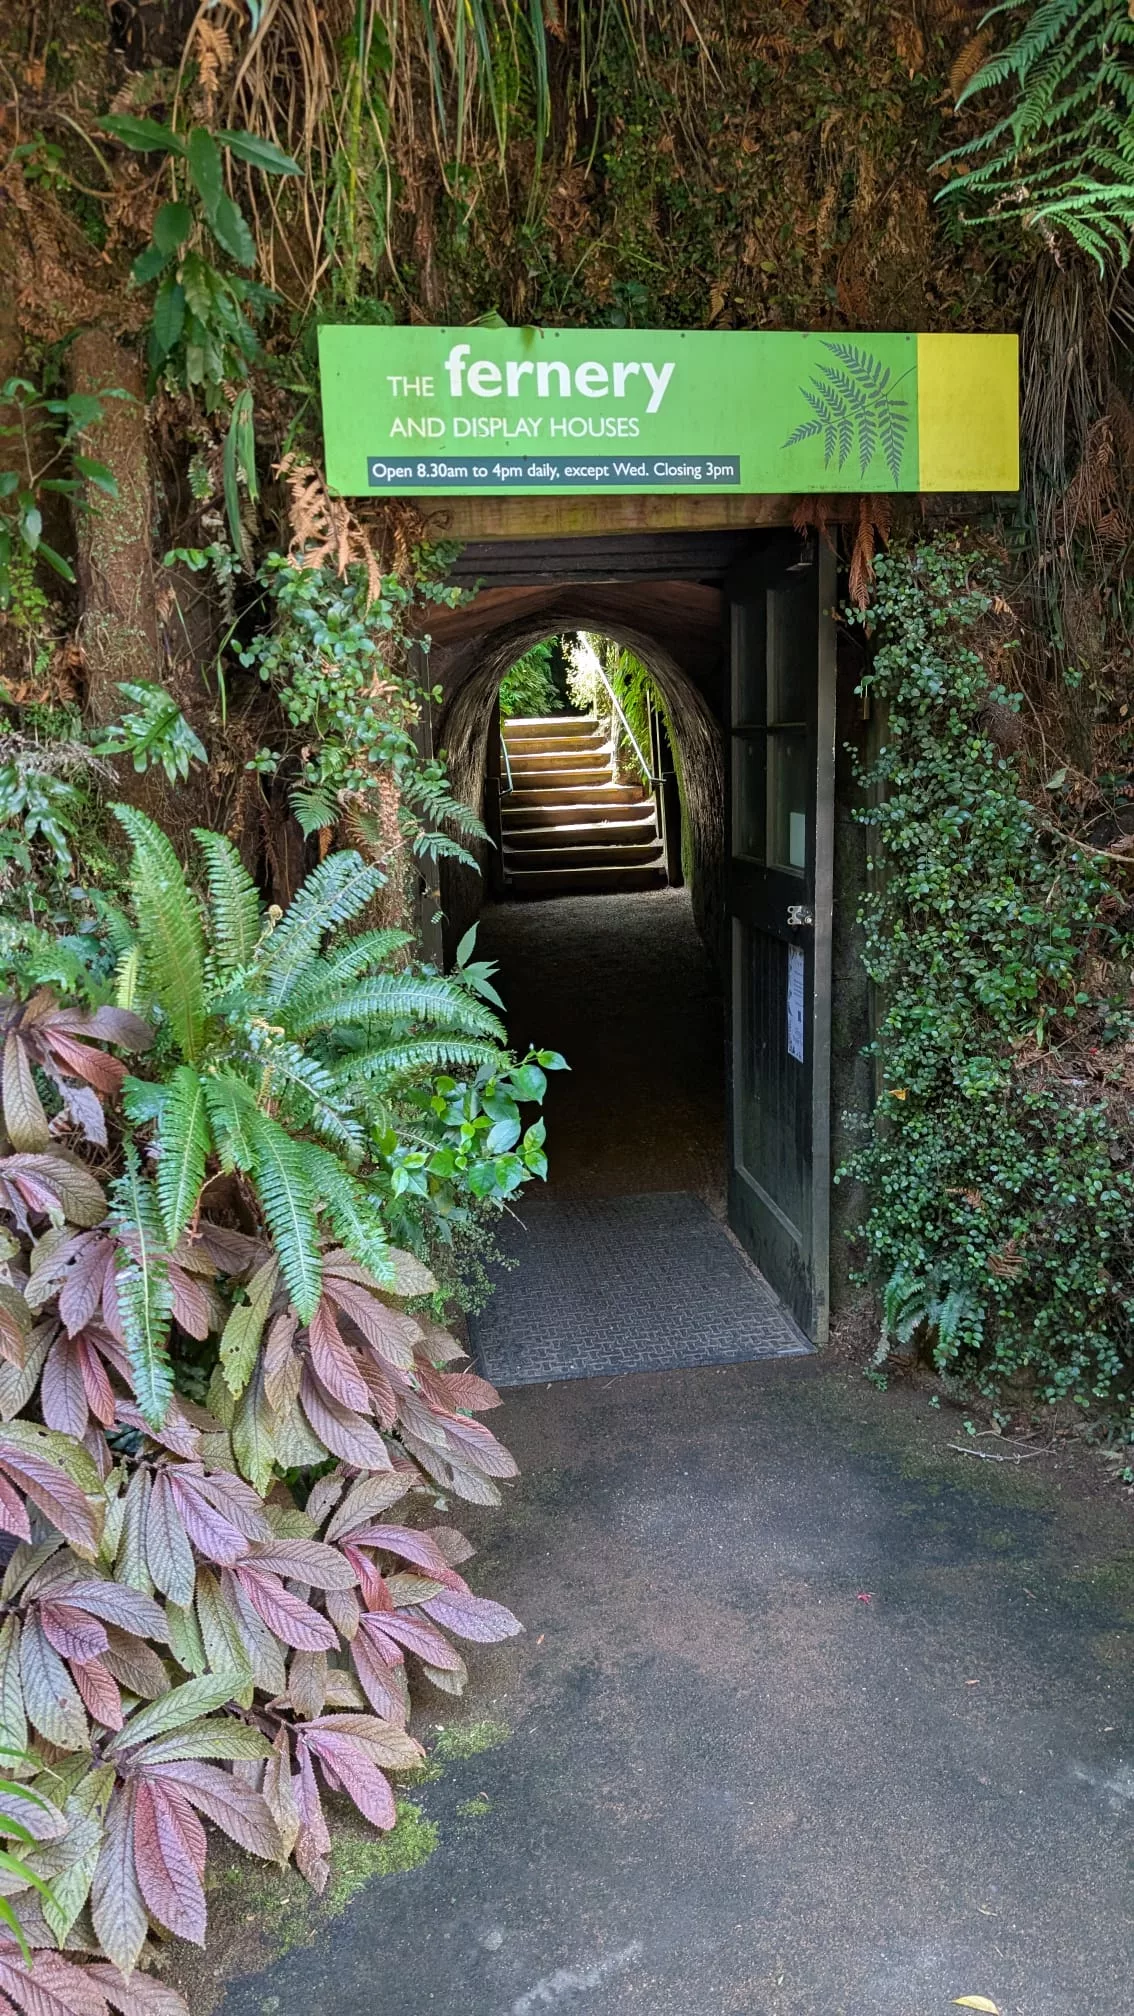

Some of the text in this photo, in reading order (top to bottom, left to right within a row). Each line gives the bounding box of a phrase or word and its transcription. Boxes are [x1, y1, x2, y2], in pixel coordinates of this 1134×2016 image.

[386, 344, 676, 413] THE fernery
[389, 416, 640, 438] AND DISPLAY HOUSES
[372, 463, 734, 481] Open 8.30am to 4pm daily, except Wed. Closing 3pm
